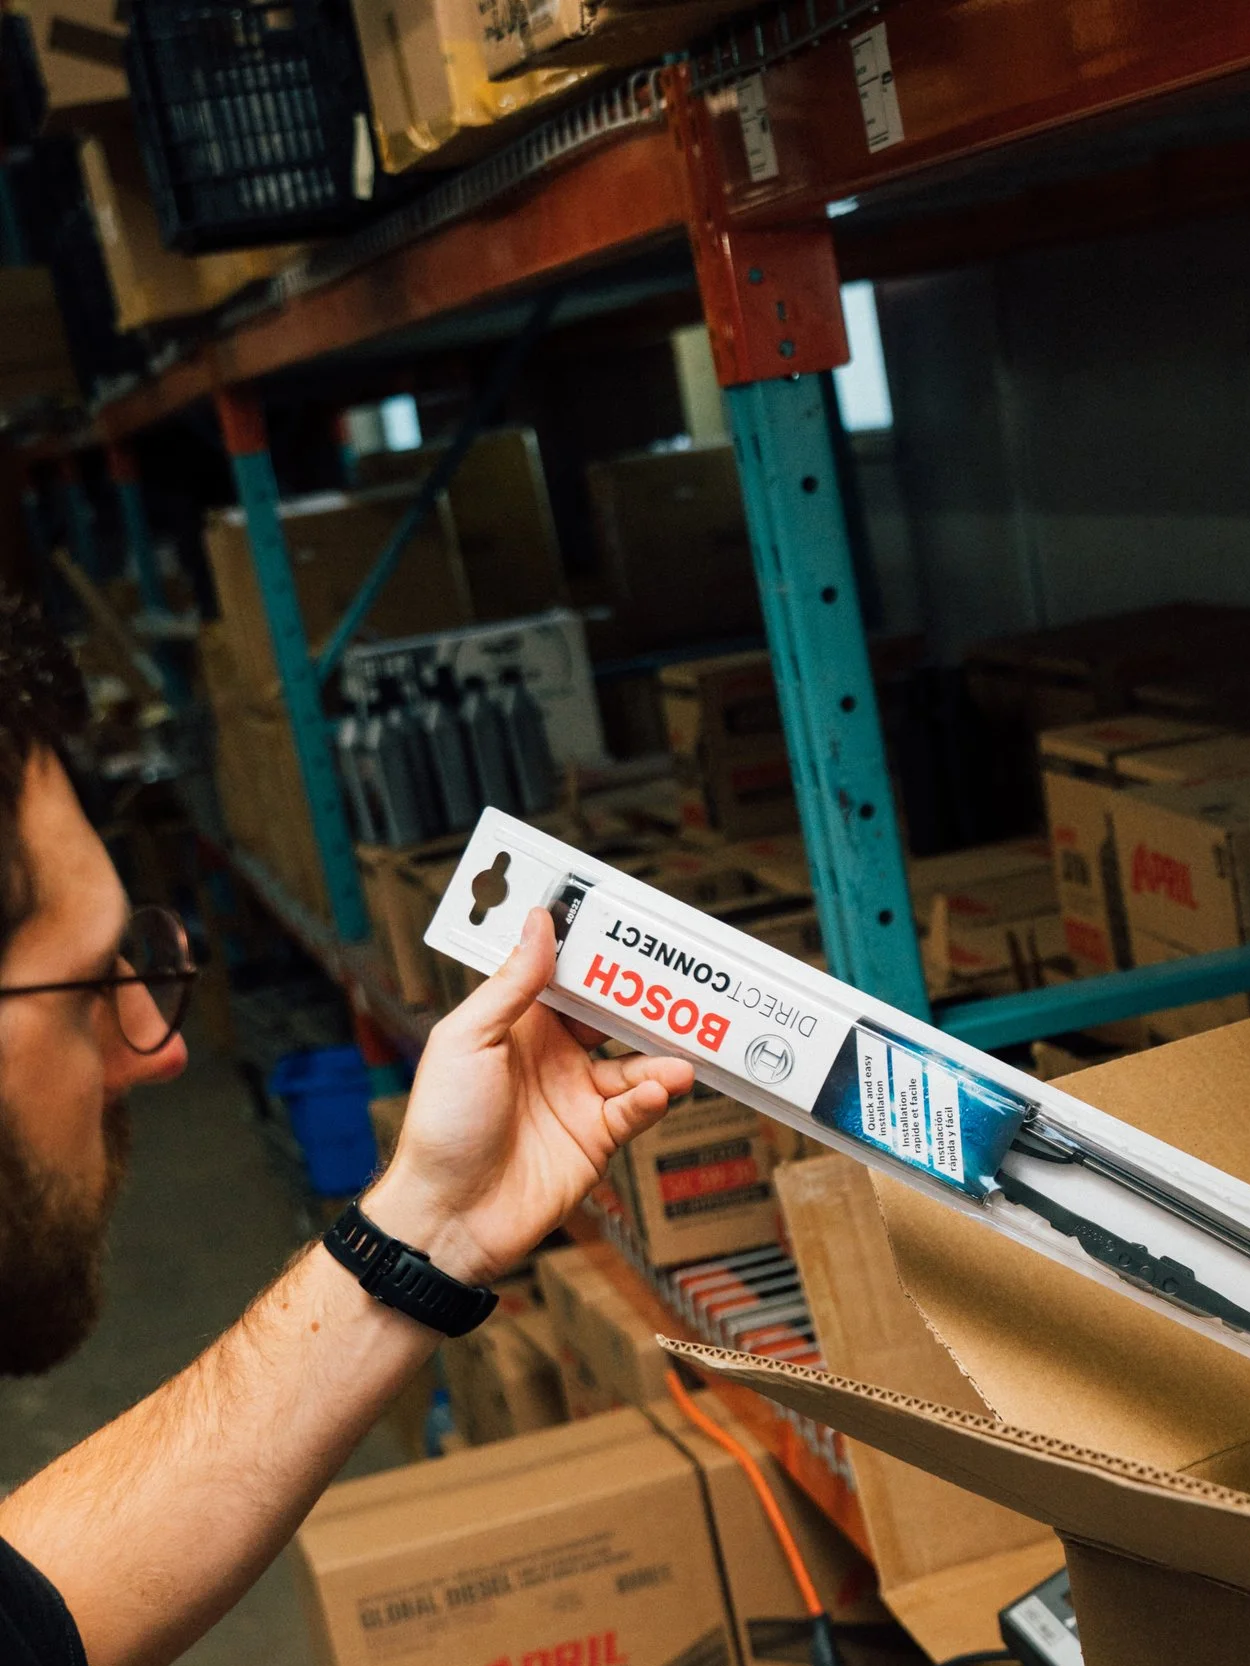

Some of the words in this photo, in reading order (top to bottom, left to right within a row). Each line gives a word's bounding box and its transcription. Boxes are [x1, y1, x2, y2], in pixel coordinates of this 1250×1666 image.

[605, 919, 819, 1038] DIRECTCONNECT
[583, 953, 732, 1053] BOSCH
[864, 1055, 873, 1078] easy
[864, 1079, 873, 1100] and
[909, 1078, 918, 1107] facile
[866, 1102, 875, 1131] Quick
[876, 1080, 886, 1136] installation
[898, 1091, 910, 1147] Installation
[910, 1108, 919, 1119] et
[944, 1106, 955, 1130] fácil
[910, 1121, 922, 1154] rapide
[933, 1110, 946, 1165] Instalación
[948, 1131, 957, 1140] y
[947, 1141, 957, 1172] rápida
